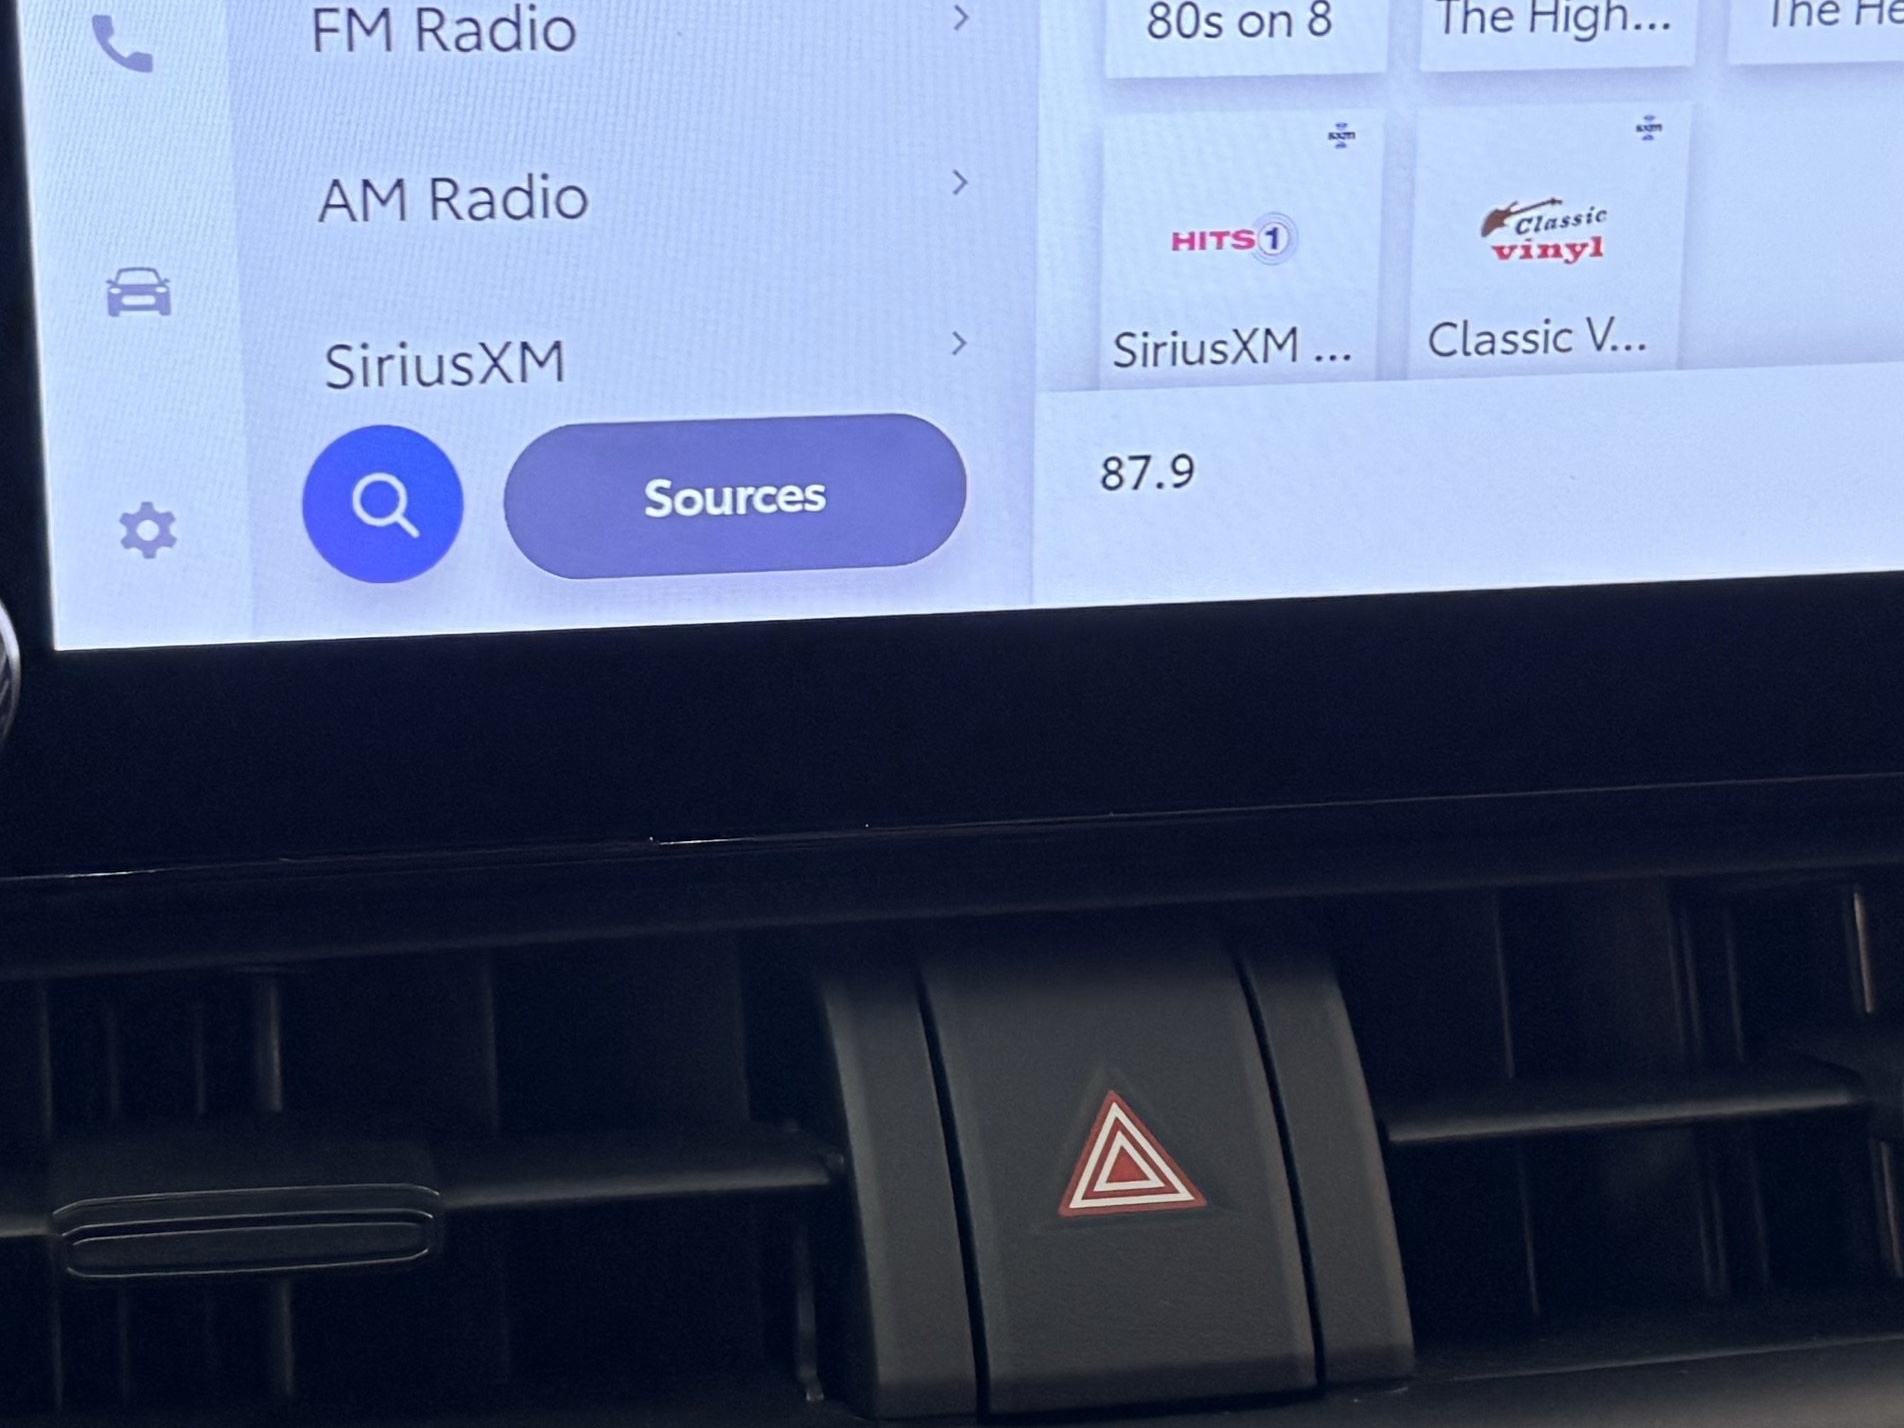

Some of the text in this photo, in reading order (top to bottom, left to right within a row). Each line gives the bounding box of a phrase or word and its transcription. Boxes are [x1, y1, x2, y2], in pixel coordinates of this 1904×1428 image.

[311, 2, 578, 55] FM Radio
[1147, 0, 1224, 40] 80s
[1238, 10, 1293, 38] on
[317, 172, 590, 225] AM Radio
[1171, 229, 1256, 252] HITS
[1514, 205, 1608, 235] Classic
[1490, 235, 1604, 265] vinyl
[1113, 326, 1299, 368] SiriusXM
[1428, 315, 1648, 357] Classic V...
[324, 339, 567, 391] SiriusXM
[1100, 452, 1196, 492] 87.9
[642, 478, 828, 521] Sources
